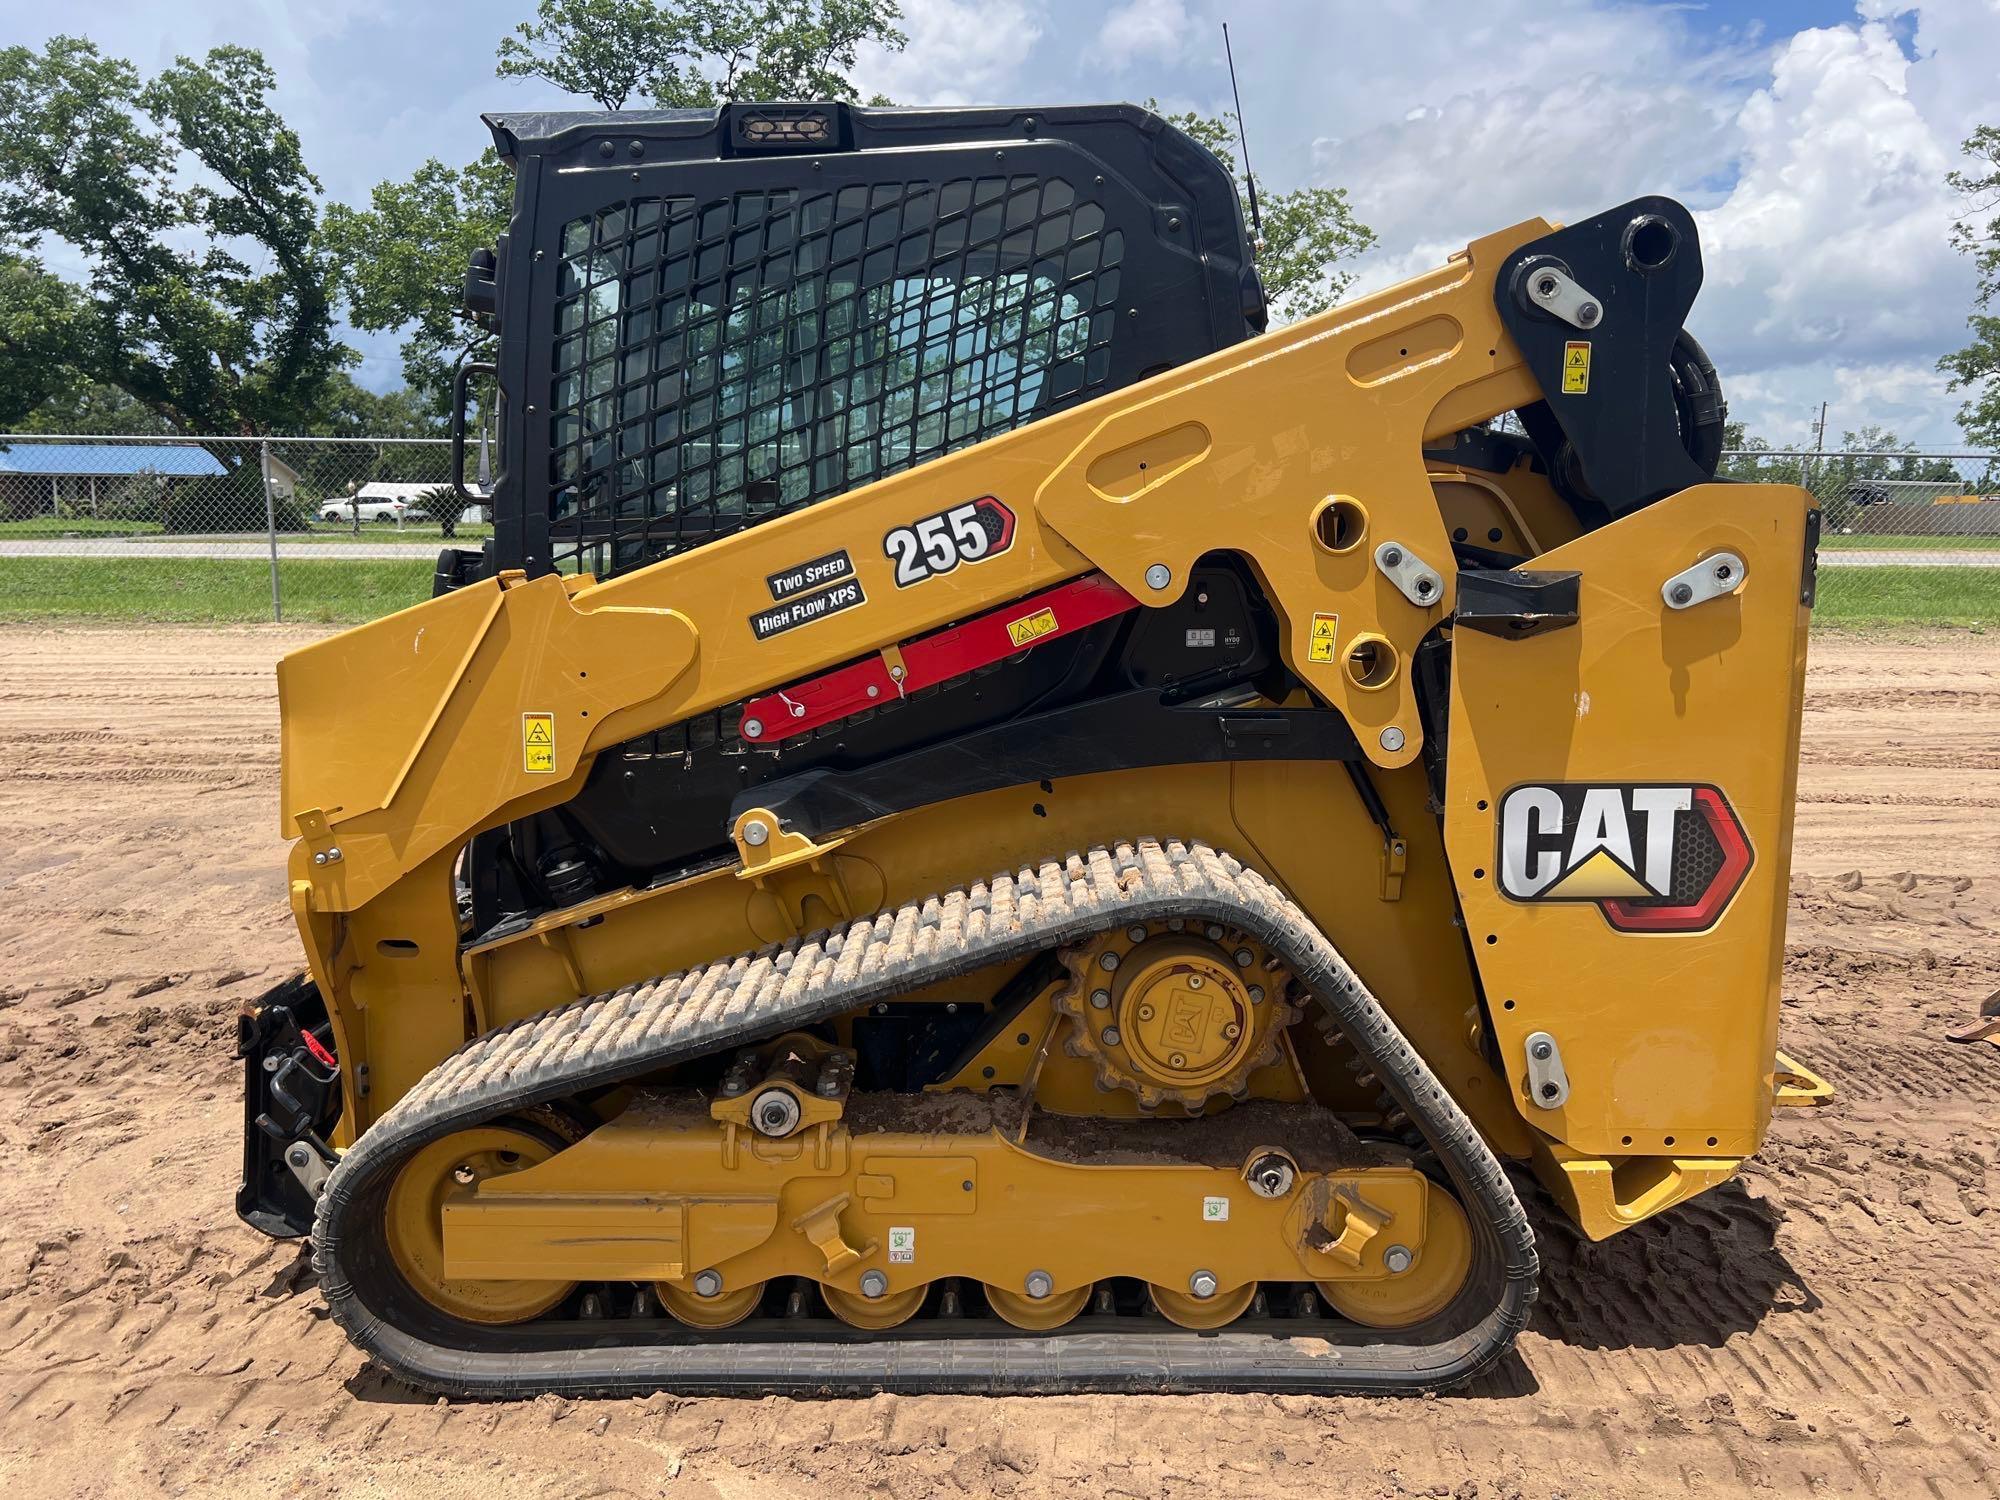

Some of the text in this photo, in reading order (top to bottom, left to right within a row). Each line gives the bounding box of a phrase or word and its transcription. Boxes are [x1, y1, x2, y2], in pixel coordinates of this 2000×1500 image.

[774, 558, 845, 594] TWO SPEED
[886, 504, 988, 584] 255
[758, 585, 857, 634] HIGH FLOW XPS
[1501, 787, 1692, 897] CAT
